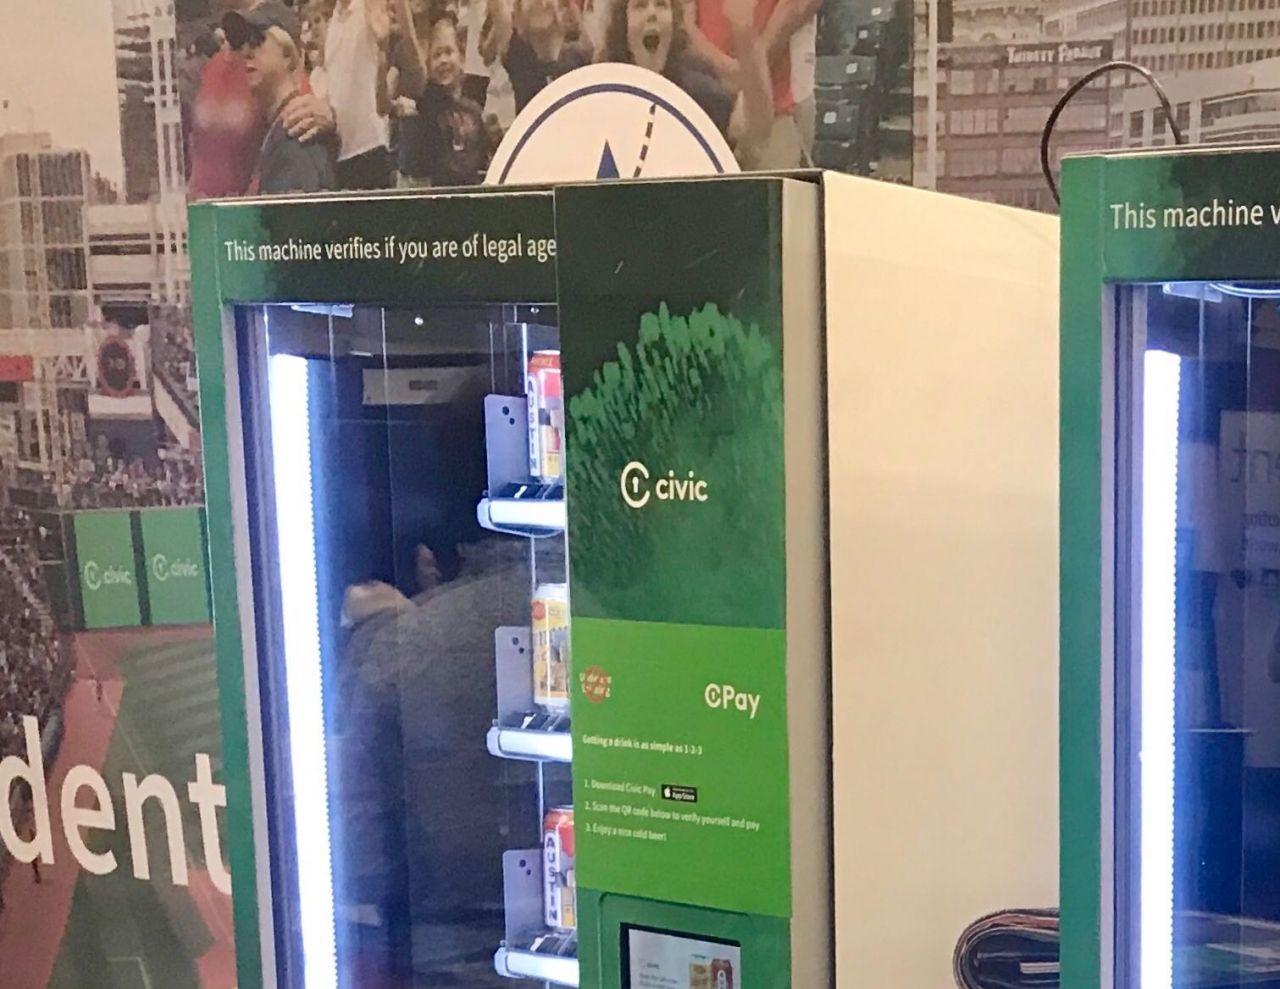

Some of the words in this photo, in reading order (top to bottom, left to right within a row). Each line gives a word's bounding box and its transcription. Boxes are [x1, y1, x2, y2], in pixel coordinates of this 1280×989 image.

[1110, 203, 1157, 230] This
[1162, 198, 1264, 229] machine
[224, 240, 255, 262] This
[259, 238, 322, 261] machine
[325, 235, 381, 260] verifies
[384, 233, 396, 258] if
[398, 240, 428, 264] you
[432, 239, 458, 258] are
[462, 232, 479, 257] of
[483, 234, 522, 263] legal
[527, 239, 556, 262] age
[656, 470, 708, 501] civic
[614, 737, 632, 748] drink
[650, 740, 673, 753] simple
[684, 744, 703, 755] 1-2-3
[591, 779, 625, 792] Download
[643, 785, 656, 798] Pay
[621, 805, 632, 816] QR
[731, 817, 745, 828] and
[746, 821, 760, 832] pay
